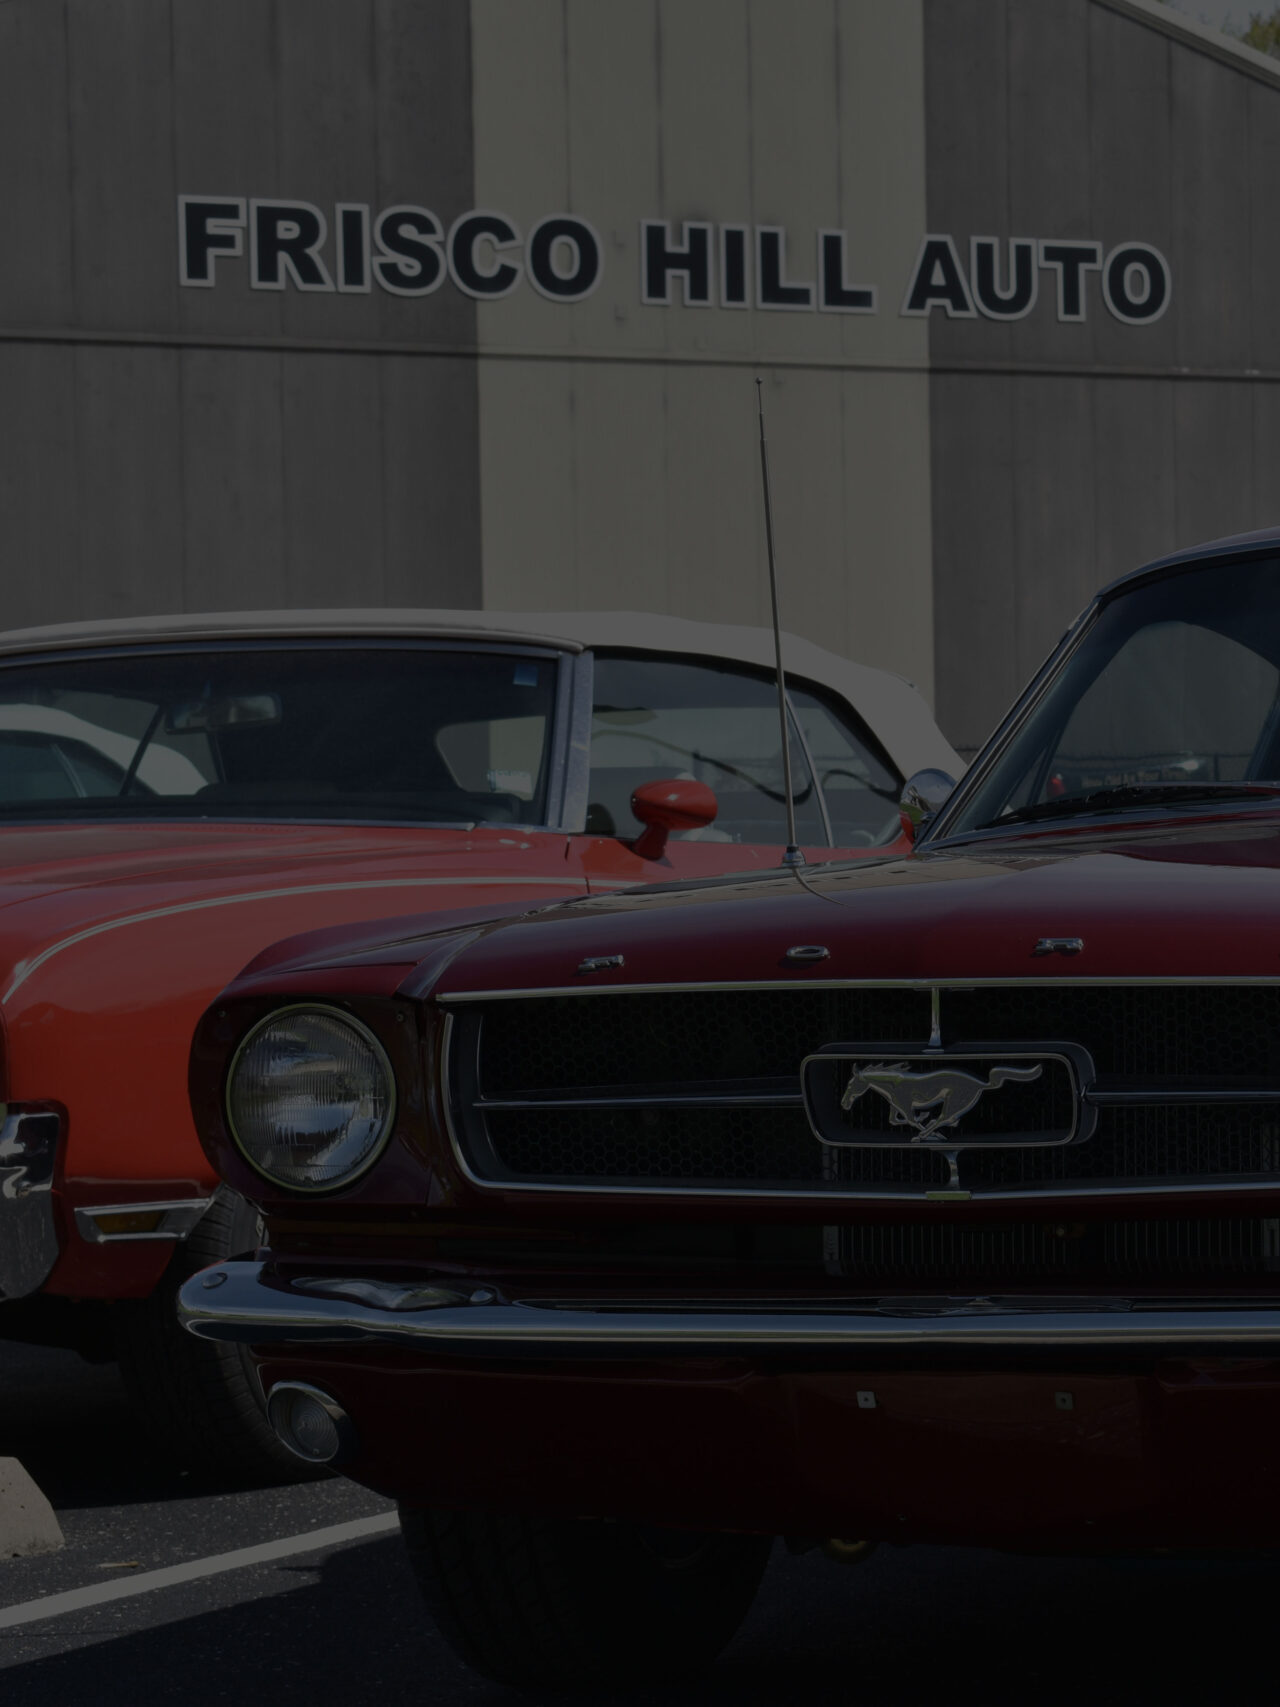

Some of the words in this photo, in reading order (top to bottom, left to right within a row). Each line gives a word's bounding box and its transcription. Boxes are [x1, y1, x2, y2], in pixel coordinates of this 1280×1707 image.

[178, 195, 603, 303] FRISCO
[641, 219, 877, 314] HILL
[900, 234, 1171, 325] AUTO
